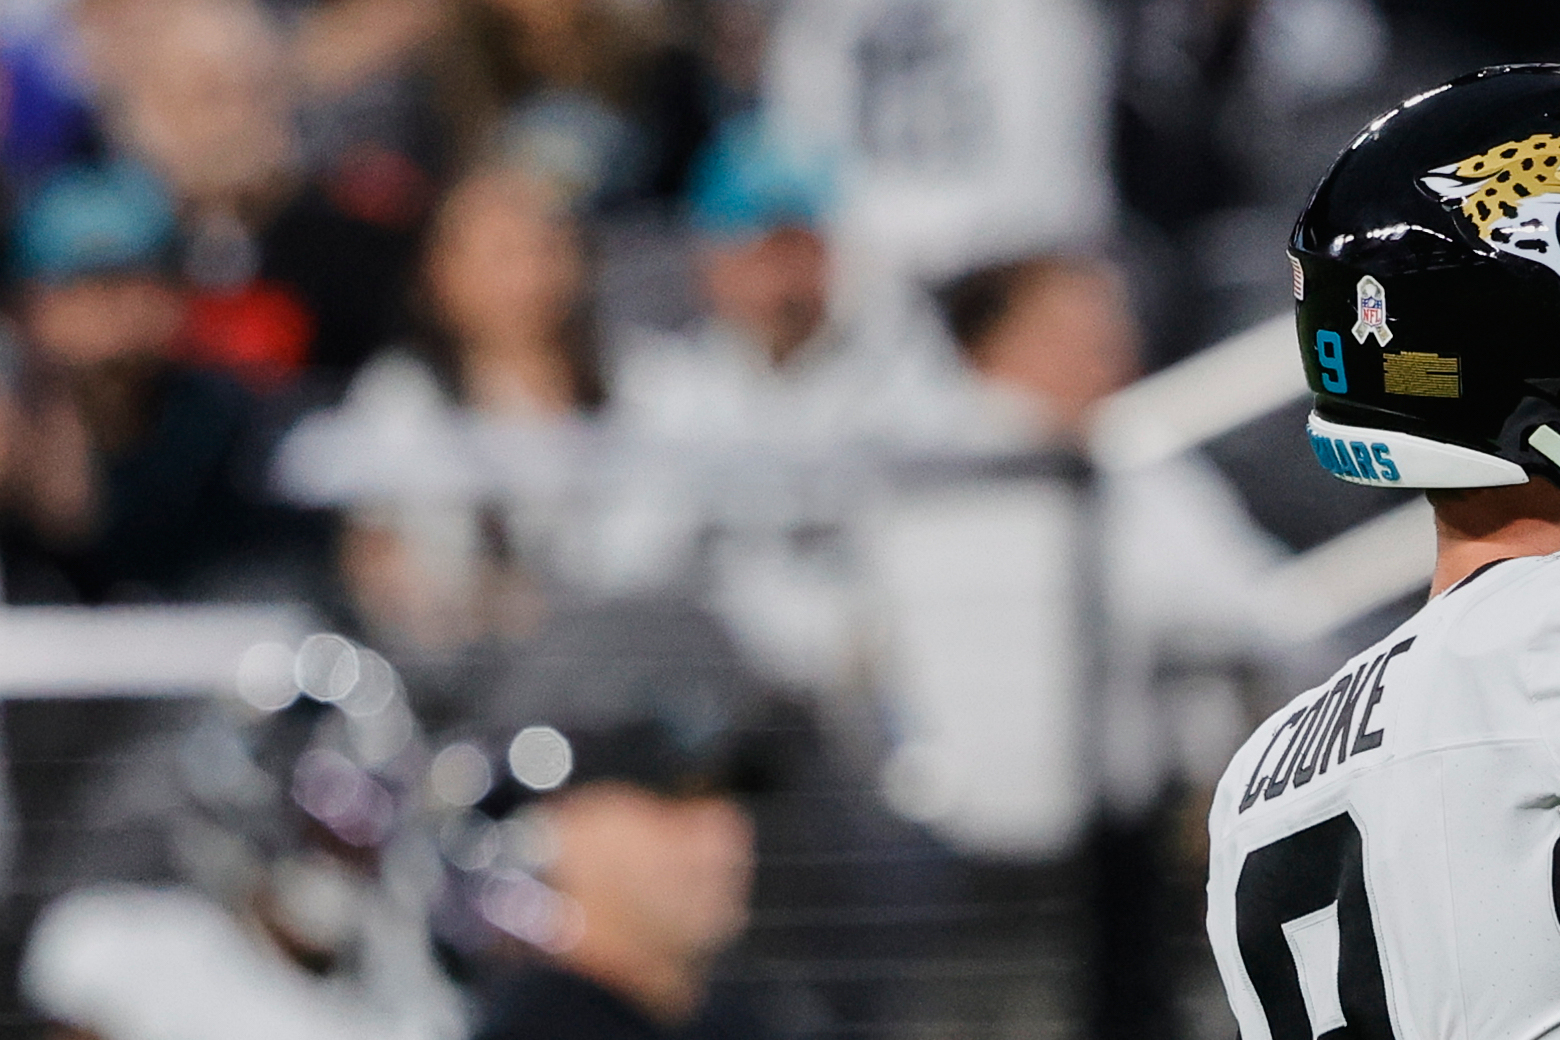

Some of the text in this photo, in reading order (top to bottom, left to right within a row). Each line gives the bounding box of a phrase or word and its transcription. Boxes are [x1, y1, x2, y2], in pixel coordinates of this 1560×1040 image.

[1363, 308, 1383, 324] NFL
[1316, 329, 1349, 394] 9
[1238, 635, 1418, 815] COOKE
